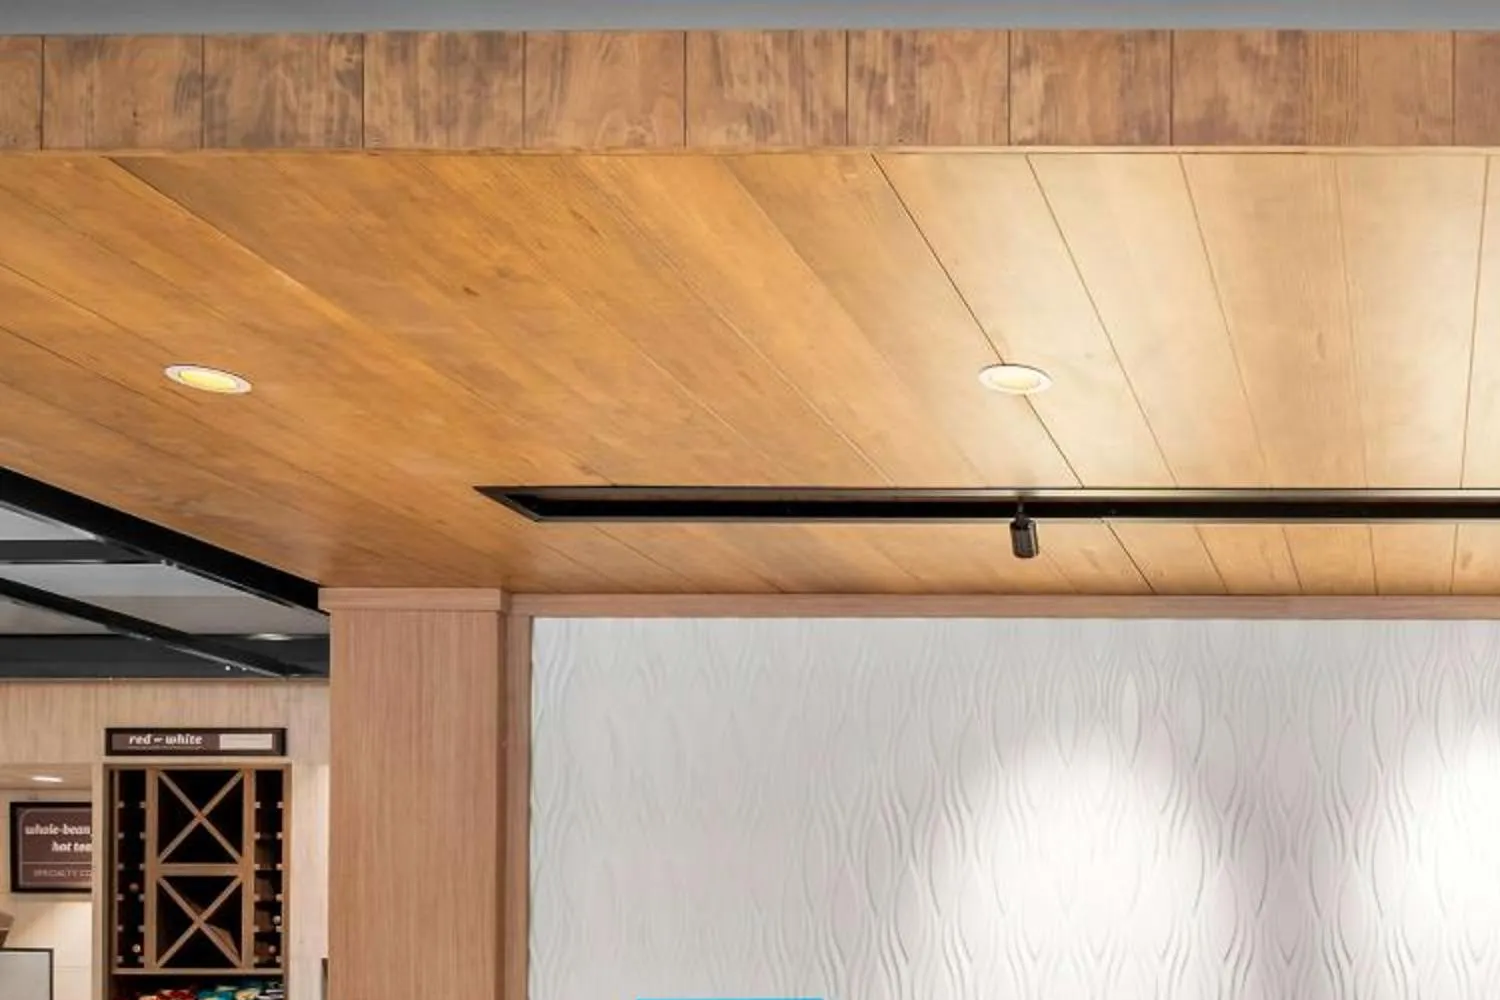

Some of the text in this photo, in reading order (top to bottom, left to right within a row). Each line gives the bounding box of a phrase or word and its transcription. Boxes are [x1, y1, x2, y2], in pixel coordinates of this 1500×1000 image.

[129, 733, 152, 745] red
[165, 733, 203, 745] white
[25, 823, 91, 835] whole-bean
[51, 841, 72, 852] hot
